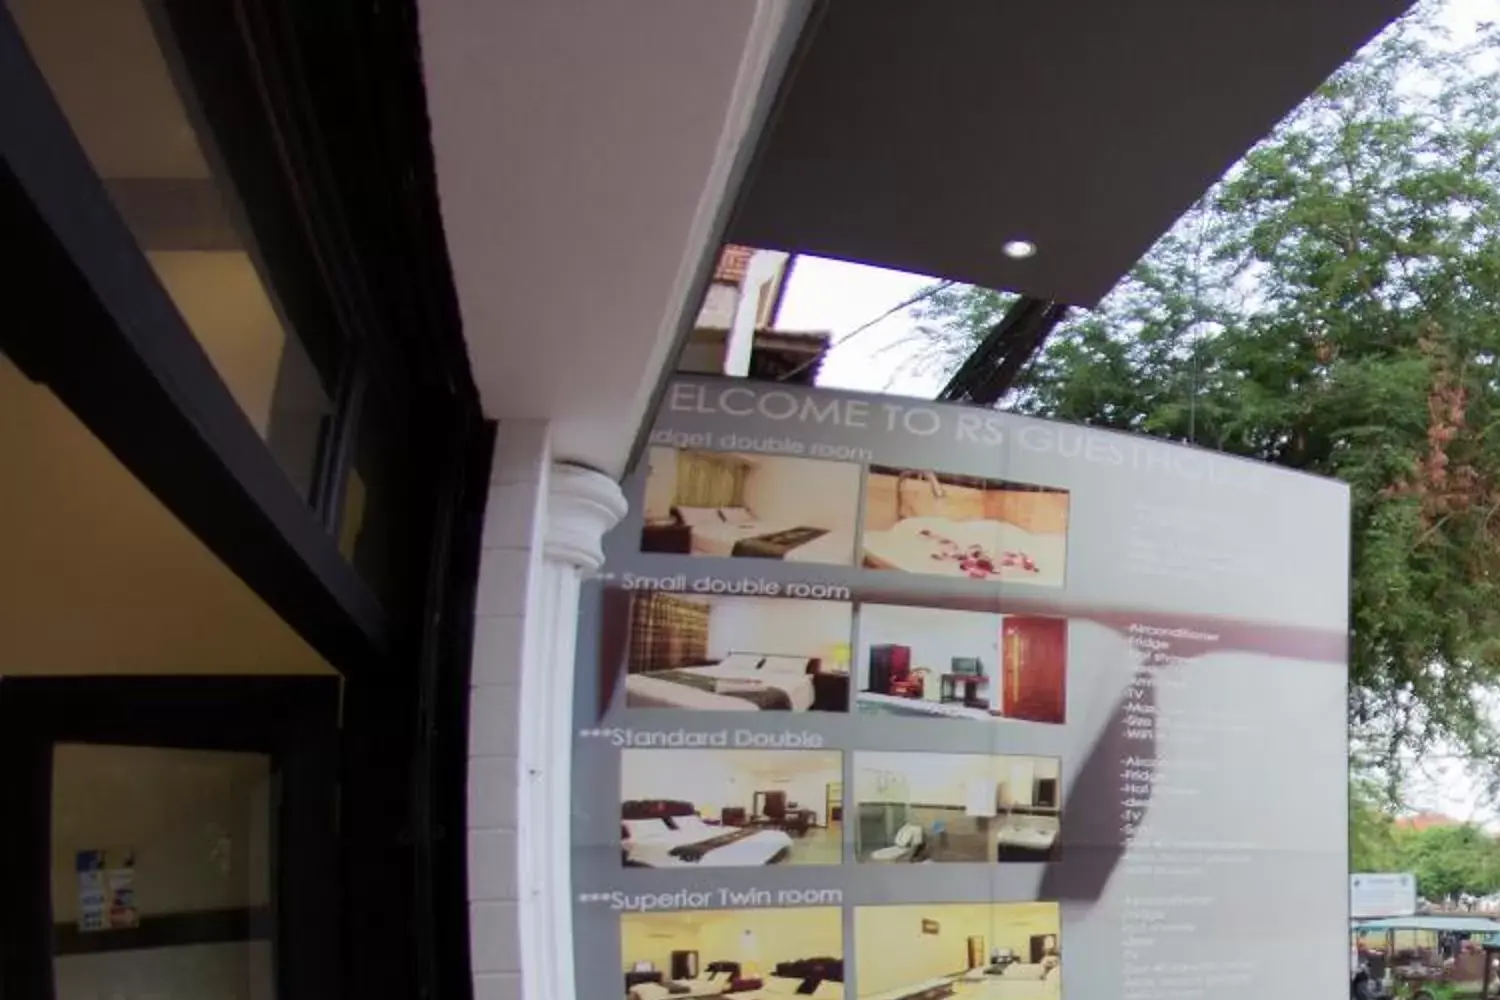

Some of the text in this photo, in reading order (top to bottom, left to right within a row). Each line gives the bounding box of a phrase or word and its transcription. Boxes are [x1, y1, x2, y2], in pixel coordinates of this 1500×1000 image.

[884, 403, 941, 437] TO
[955, 413, 1003, 447] RS
[720, 433, 806, 454] double
[810, 443, 873, 461] room
[622, 573, 851, 600] Small double room
[735, 728, 824, 747] Double
[718, 888, 772, 906] Twin
[778, 887, 843, 906] room
